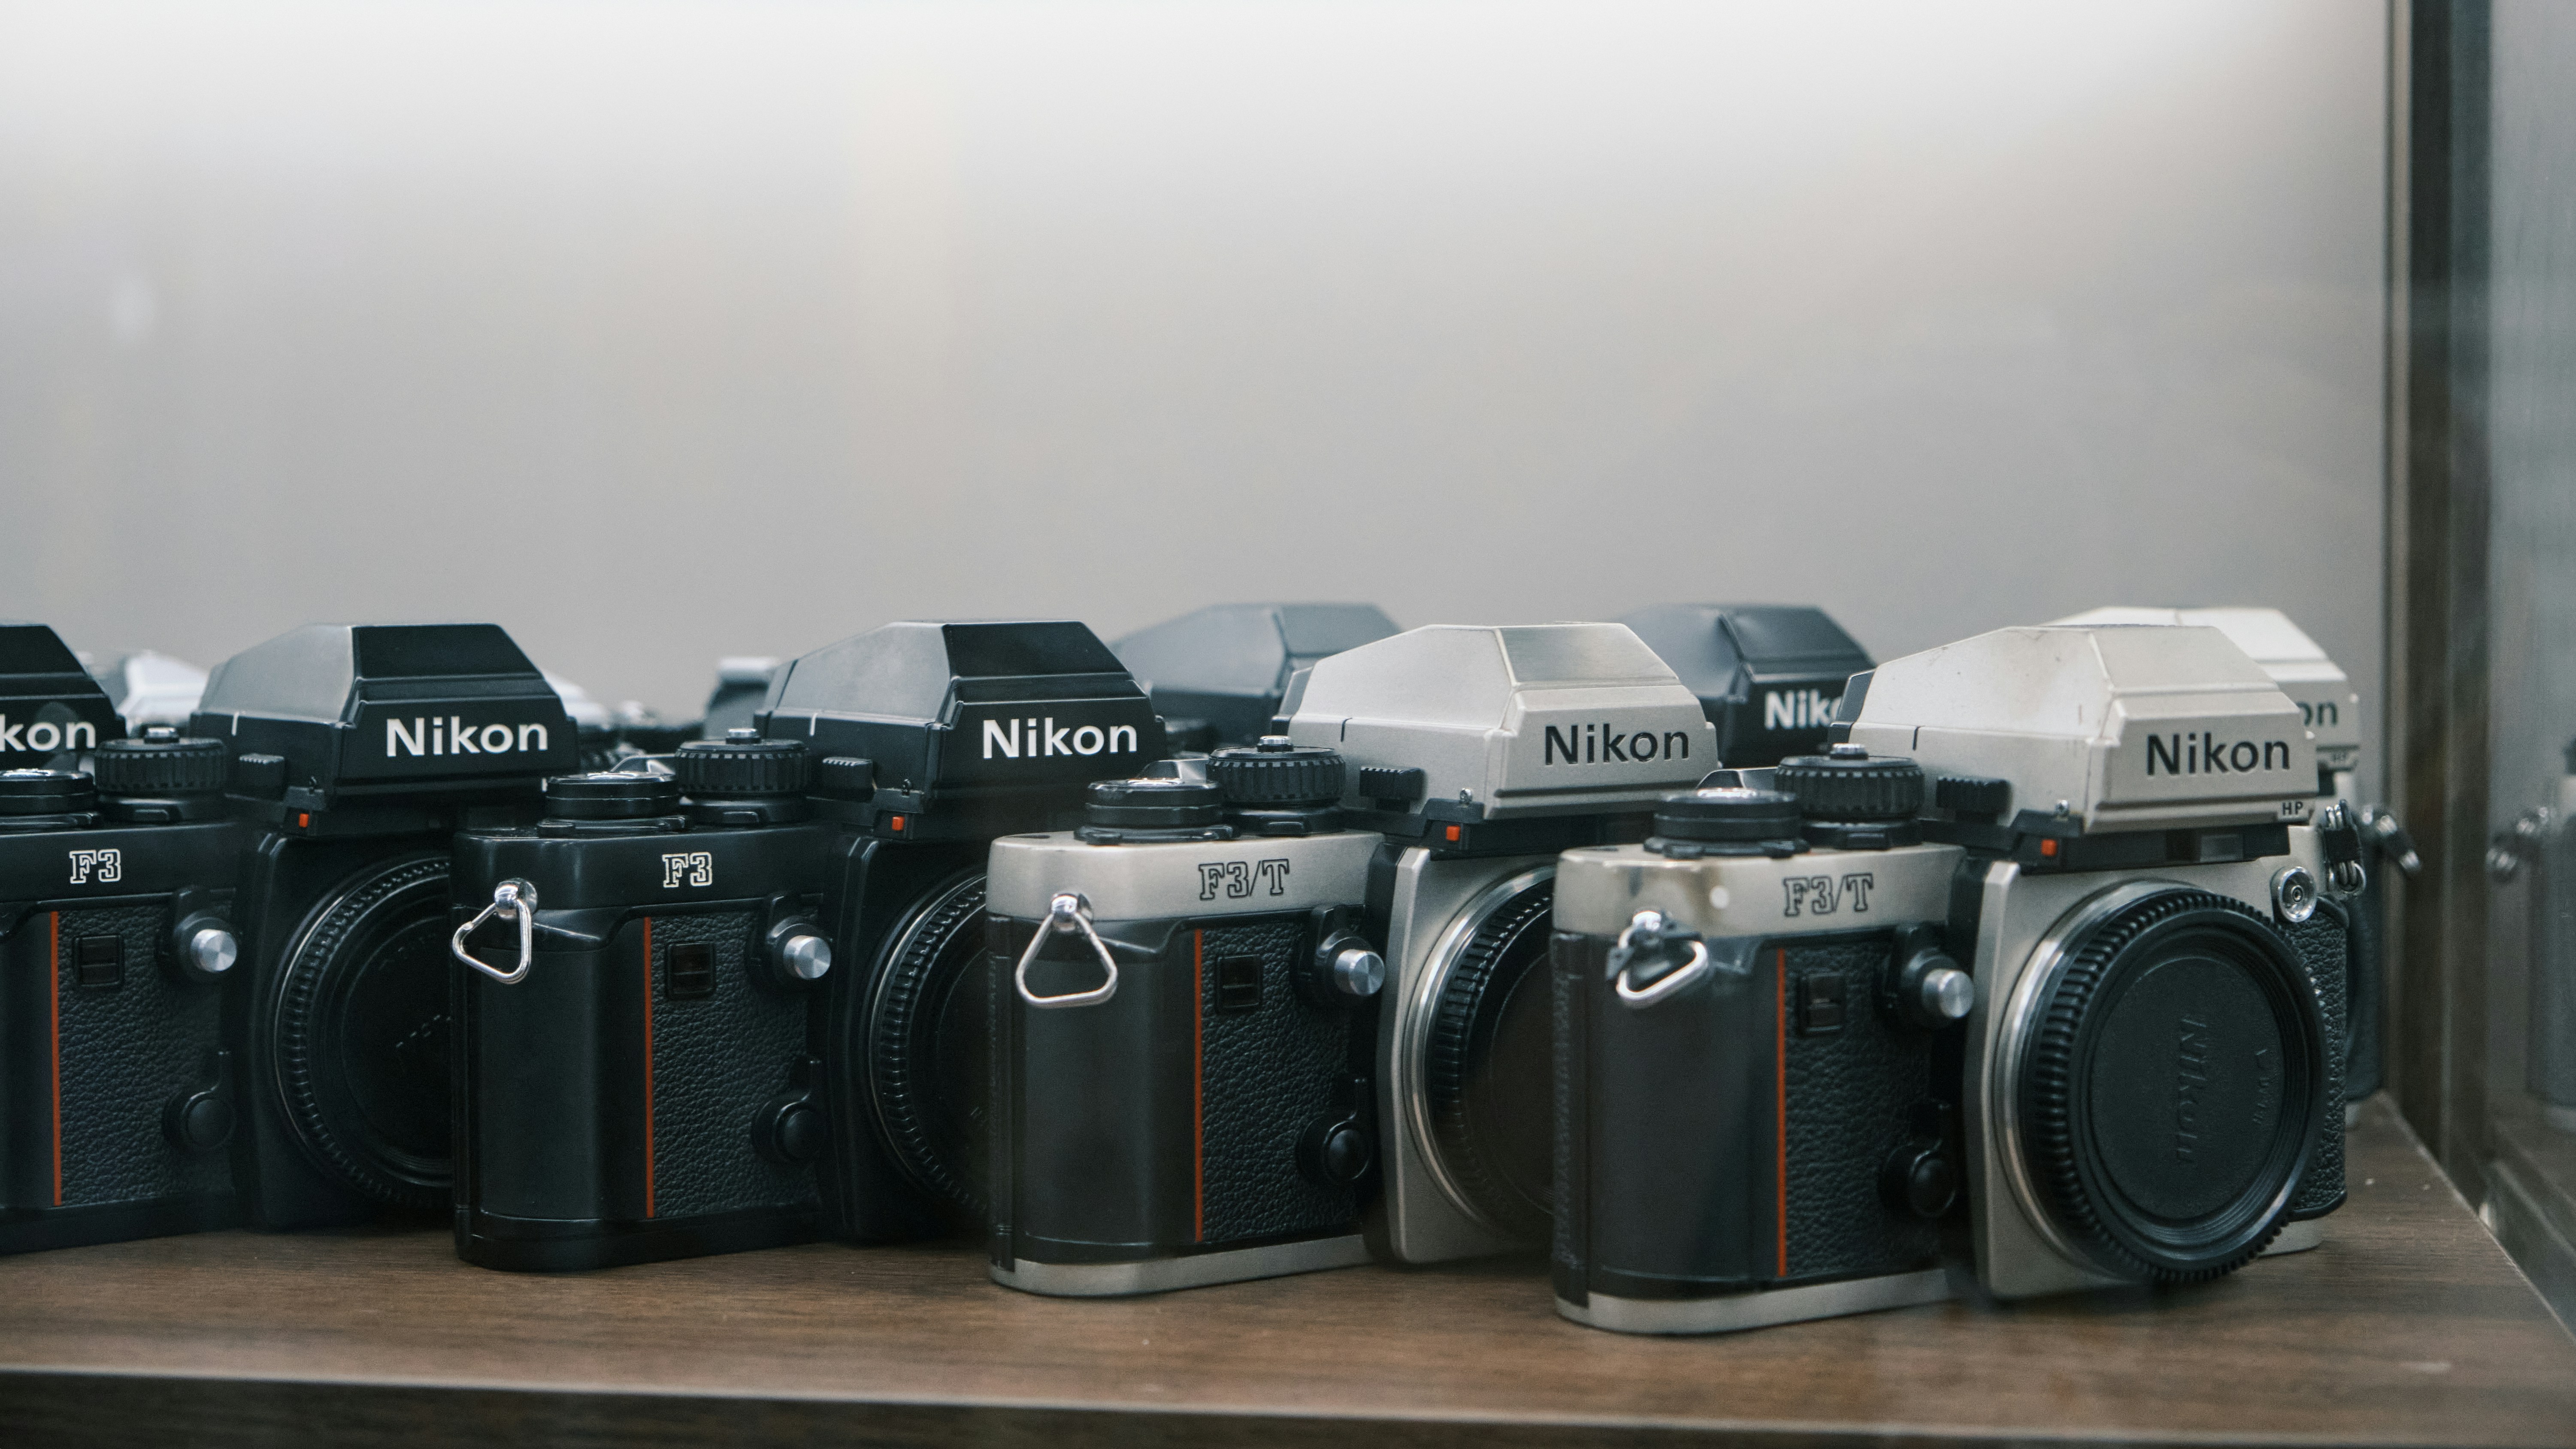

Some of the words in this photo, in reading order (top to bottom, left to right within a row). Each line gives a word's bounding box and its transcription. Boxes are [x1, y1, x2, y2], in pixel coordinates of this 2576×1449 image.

[0, 714, 96, 752] kon
[387, 716, 548, 757] Nikon
[983, 717, 1137, 759] Nikon
[1545, 723, 1689, 765] Nikon
[2146, 732, 2290, 776] Nikon
[2282, 801, 2304, 816] HP
[69, 848, 121, 884] F3
[662, 852, 713, 888] F3
[1198, 858, 1290, 902] F3/T
[1782, 872, 1875, 917] F3/T
